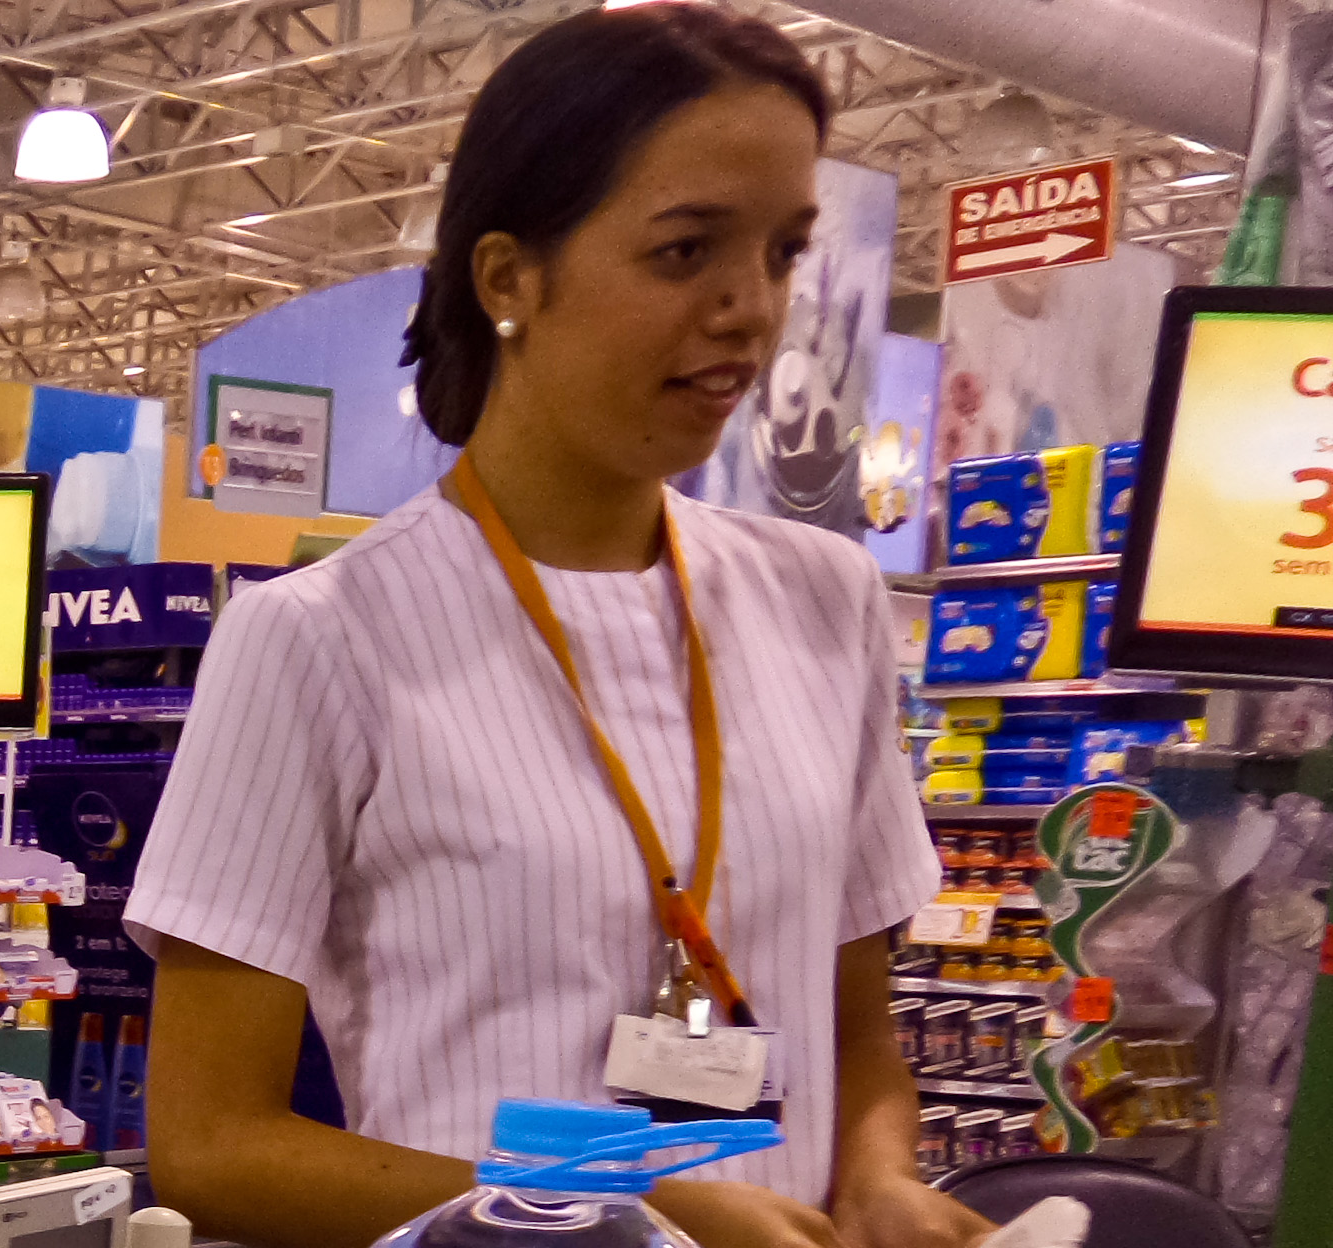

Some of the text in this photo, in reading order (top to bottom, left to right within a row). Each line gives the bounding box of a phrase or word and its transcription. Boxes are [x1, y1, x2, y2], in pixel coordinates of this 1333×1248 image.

[959, 172, 1102, 224] SAÍDA
[47, 586, 143, 628] IVEA
[165, 595, 211, 613] NIVEA
